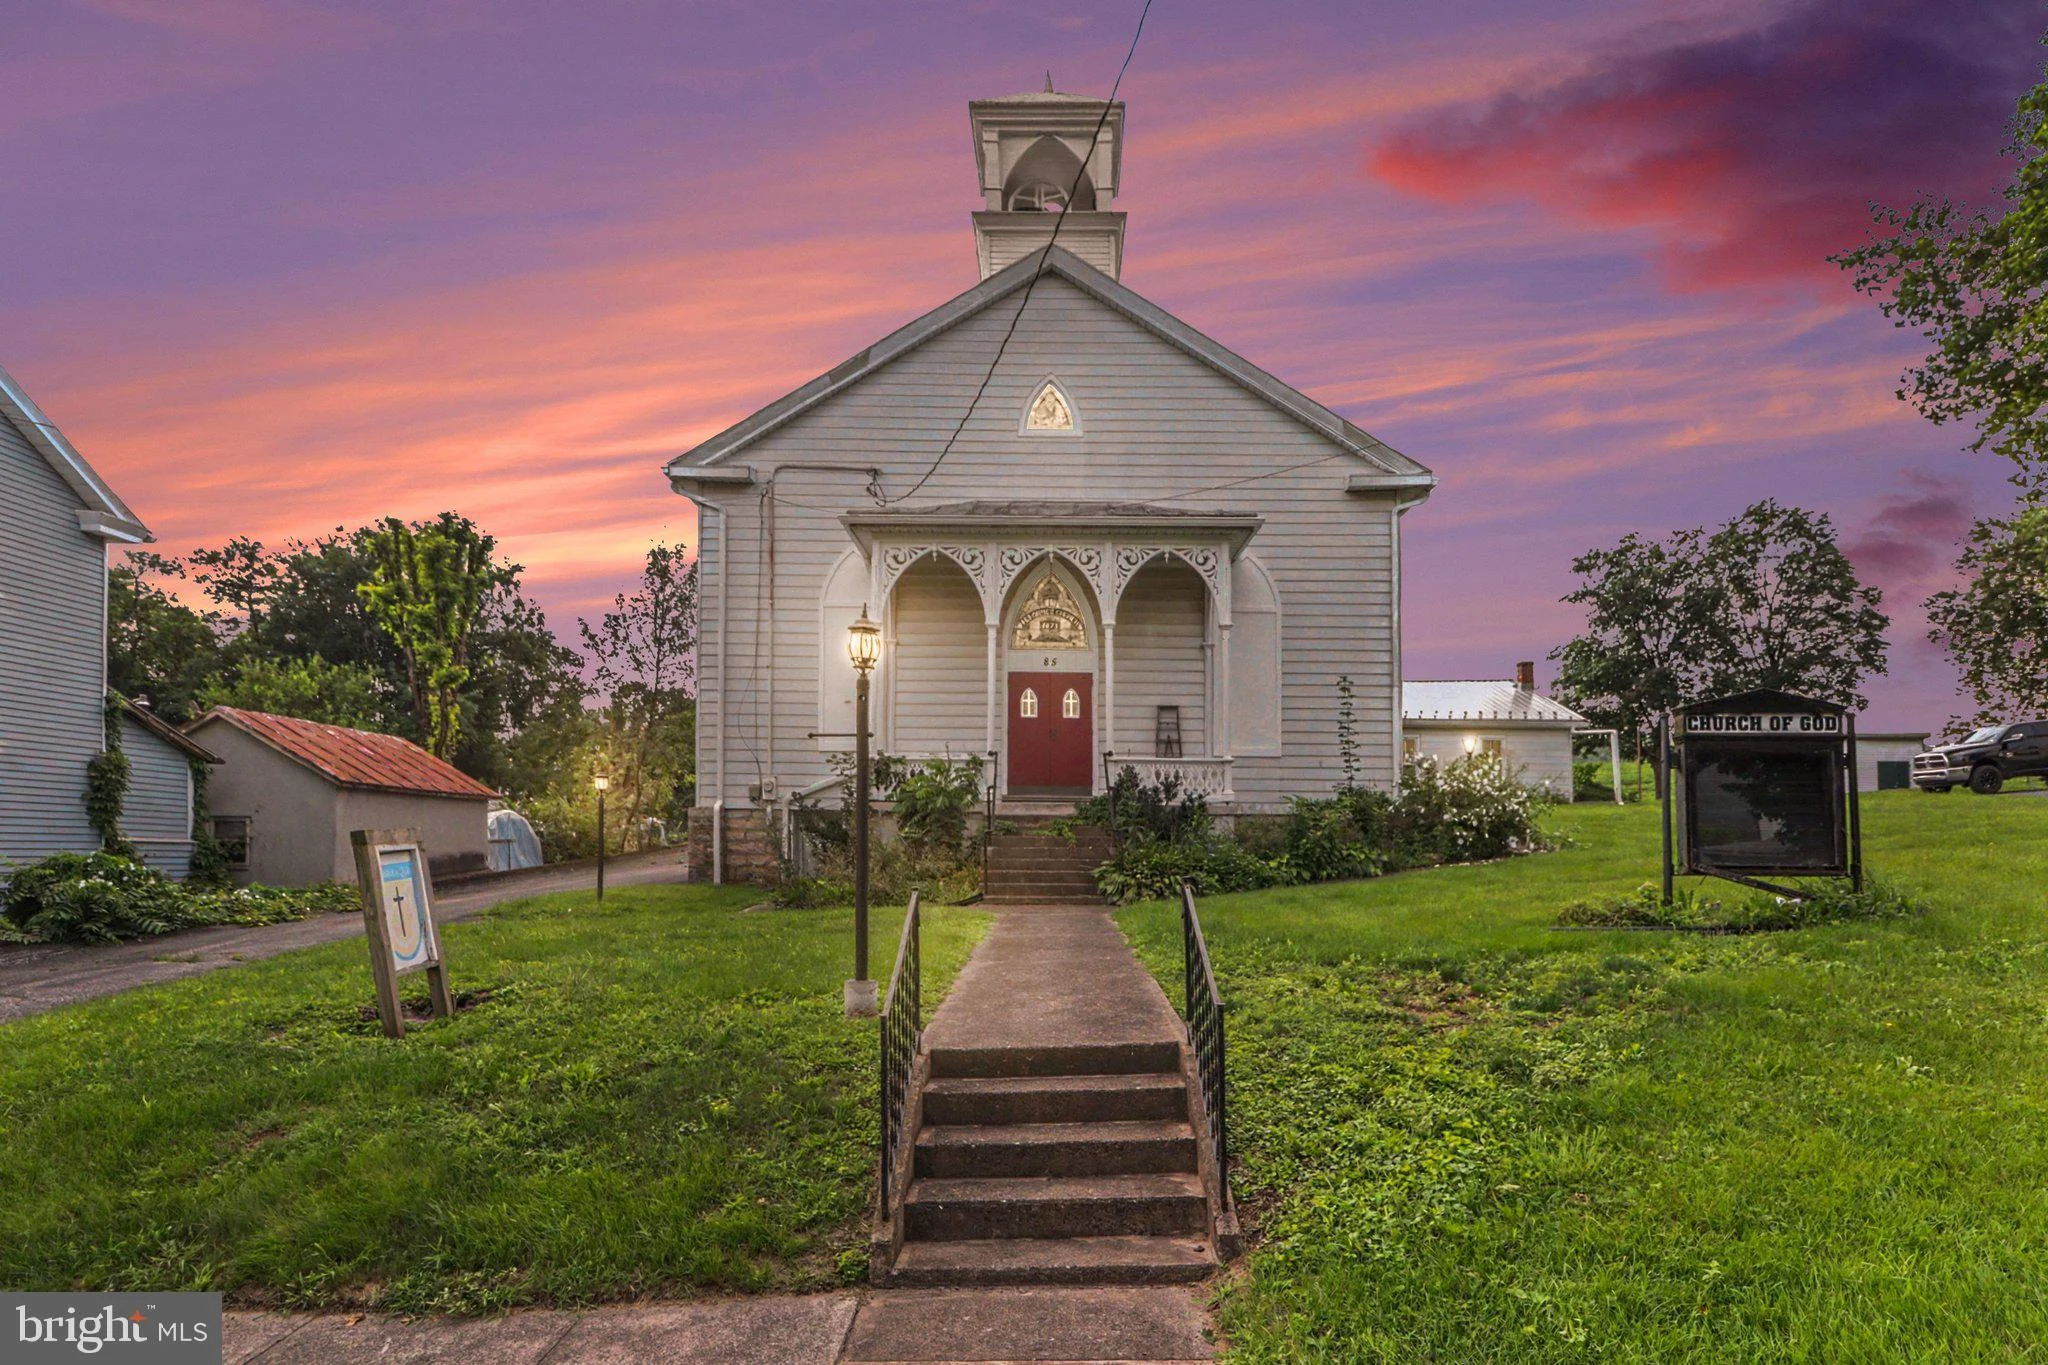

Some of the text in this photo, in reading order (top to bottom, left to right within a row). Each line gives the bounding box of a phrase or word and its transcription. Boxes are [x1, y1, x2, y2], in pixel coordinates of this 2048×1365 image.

[1043, 656, 1058, 667] 85
[1687, 715, 1838, 732] CHURCH OF GOD
